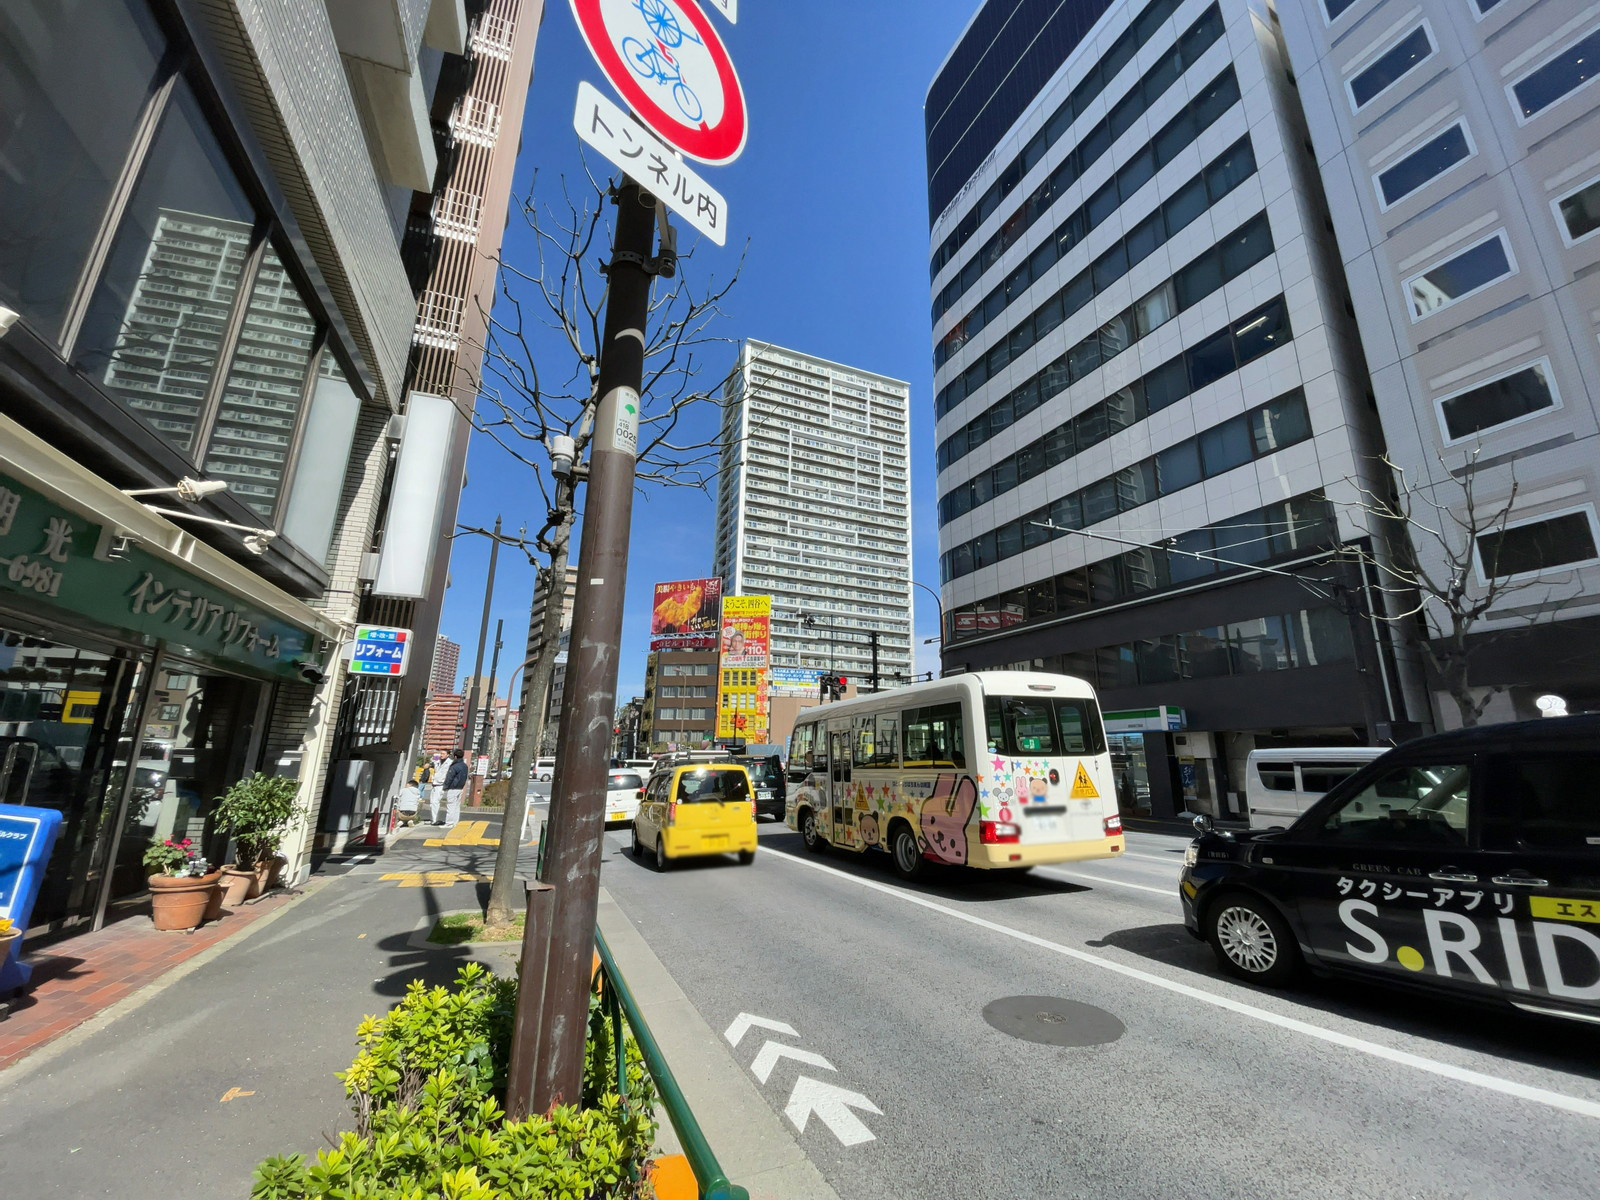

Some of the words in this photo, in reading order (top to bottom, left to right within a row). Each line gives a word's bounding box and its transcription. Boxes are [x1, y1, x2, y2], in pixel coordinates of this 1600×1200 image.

[591, 104, 717, 229] トンネル内
[130, 572, 279, 659] インテリアリフォーム
[356, 643, 402, 659] リフォーム
[1352, 863, 1391, 873] GREEN
[1397, 866, 1422, 876] CAB
[1336, 877, 1515, 915] タクシーアプリ
[1557, 902, 1597, 918] エス
